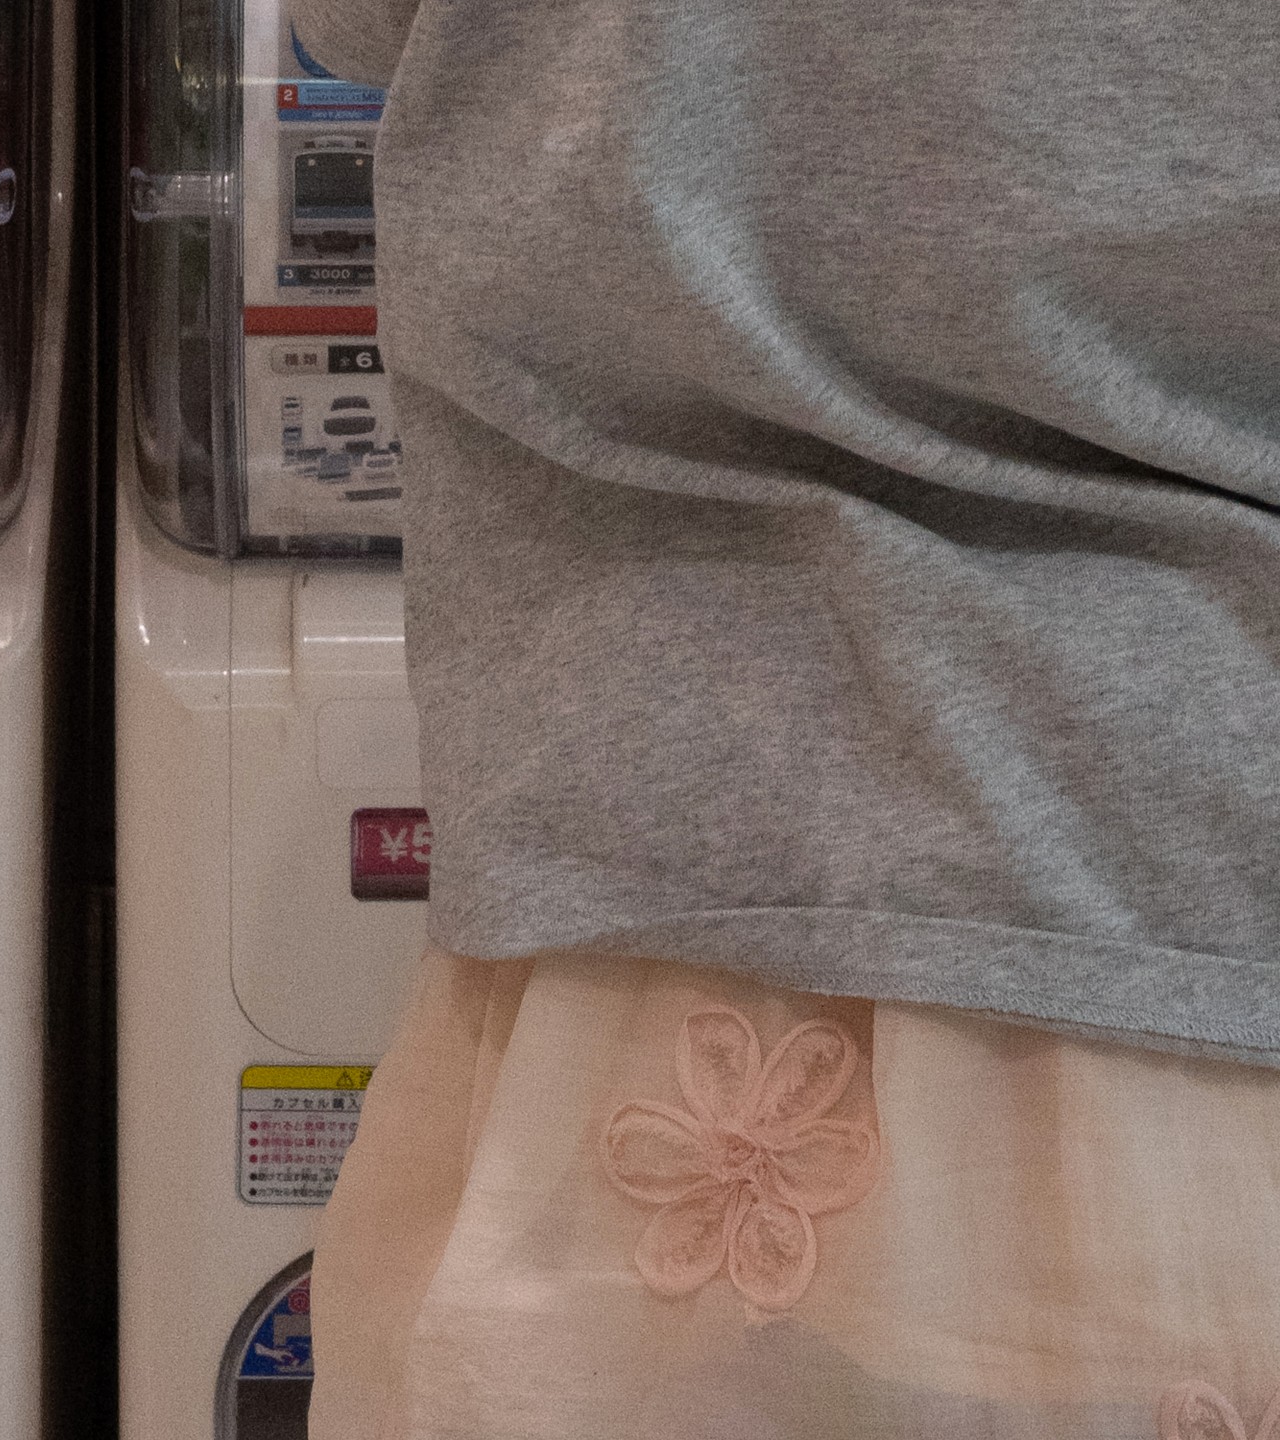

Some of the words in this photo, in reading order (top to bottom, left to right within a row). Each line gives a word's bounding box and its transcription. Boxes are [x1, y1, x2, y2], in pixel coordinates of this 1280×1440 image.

[282, 89, 294, 101] 2
[283, 269, 294, 280] 3
[310, 268, 351, 280] 3000
